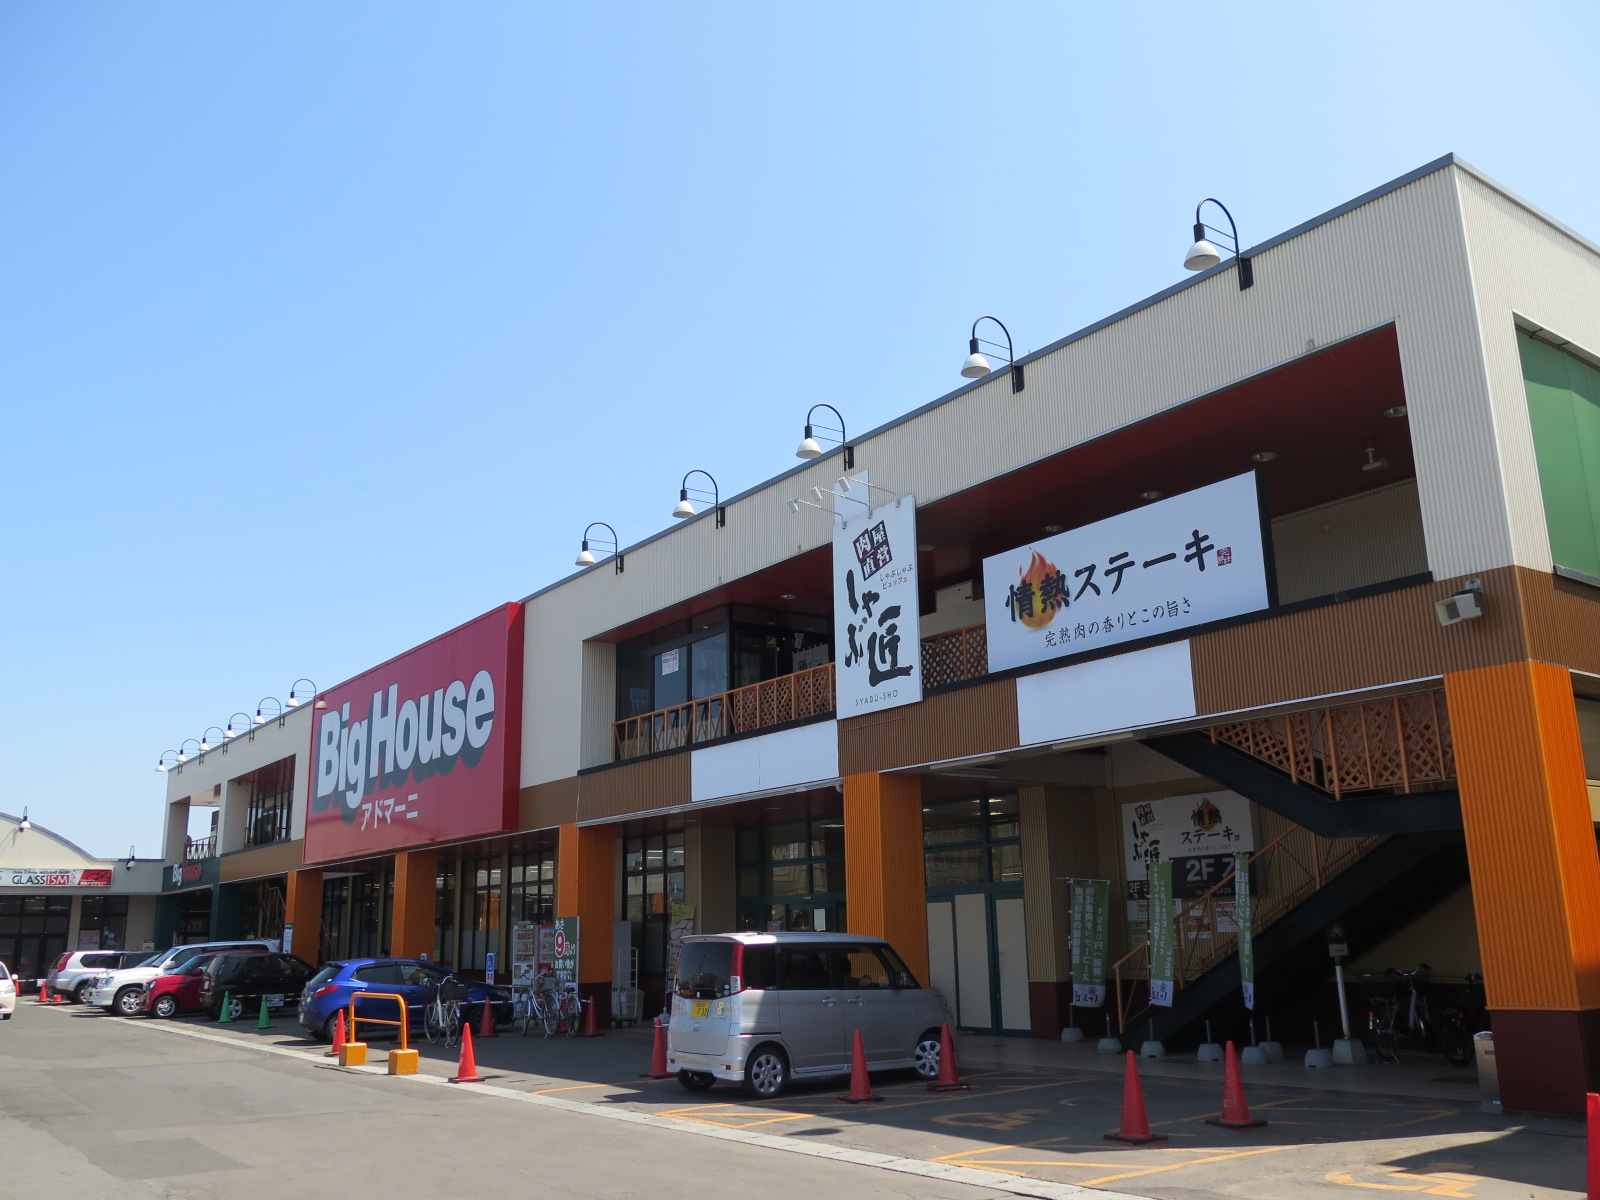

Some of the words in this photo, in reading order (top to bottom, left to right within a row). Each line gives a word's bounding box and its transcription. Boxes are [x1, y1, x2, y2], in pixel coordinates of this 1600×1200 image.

[882, 575, 908, 590] ビュッフェ
[1005, 529, 1215, 623] 情熱ステーキ
[1044, 596, 1192, 649] 完熟肉の香りとこの旨さ
[854, 689, 899, 707] SYABU-SHO
[360, 792, 419, 832] アドマーニ
[1191, 807, 1223, 827] 情熱
[1181, 826, 1234, 845] ステーキ
[1185, 858, 1215, 882] 2F
[1128, 882, 1141, 893] 2F
